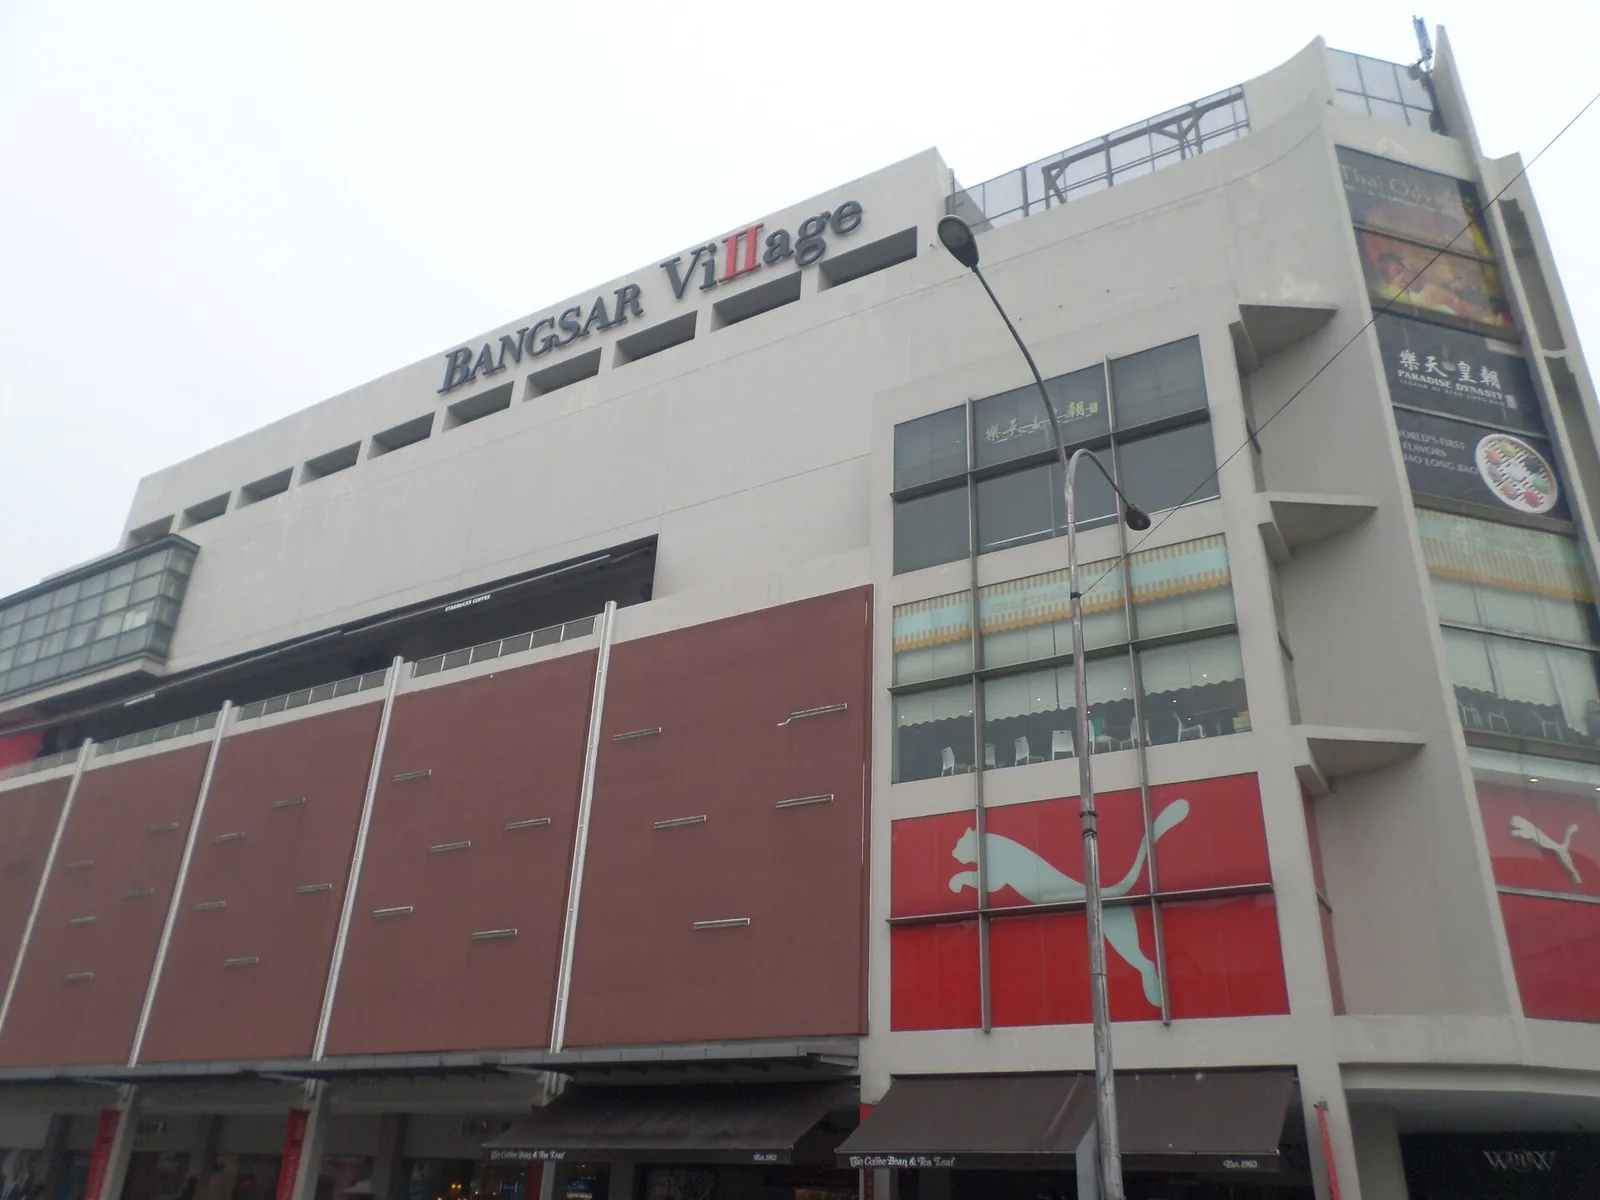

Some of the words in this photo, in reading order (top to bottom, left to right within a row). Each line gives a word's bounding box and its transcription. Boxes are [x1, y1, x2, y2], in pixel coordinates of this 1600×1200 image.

[1340, 163, 1384, 192] Thai
[437, 283, 644, 394] BANGSAR
[1398, 369, 1452, 388] PARADISE
[1456, 383, 1503, 400] DYNASTY
[1403, 441, 1447, 458] FLAVORS
[1440, 438, 1465, 450] FIRST
[1425, 458, 1456, 470] LONG
[1457, 464, 1477, 475] BAO
[445, 600, 472, 612] STARBUCKS
[472, 594, 491, 604] COFFEE
[849, 1155, 863, 1168] The
[864, 1156, 887, 1166] Coffee
[887, 1155, 908, 1167] Bean
[909, 1157, 917, 1166] &
[917, 1156, 932, 1166] Tea
[934, 1156, 956, 1166] Leaf
